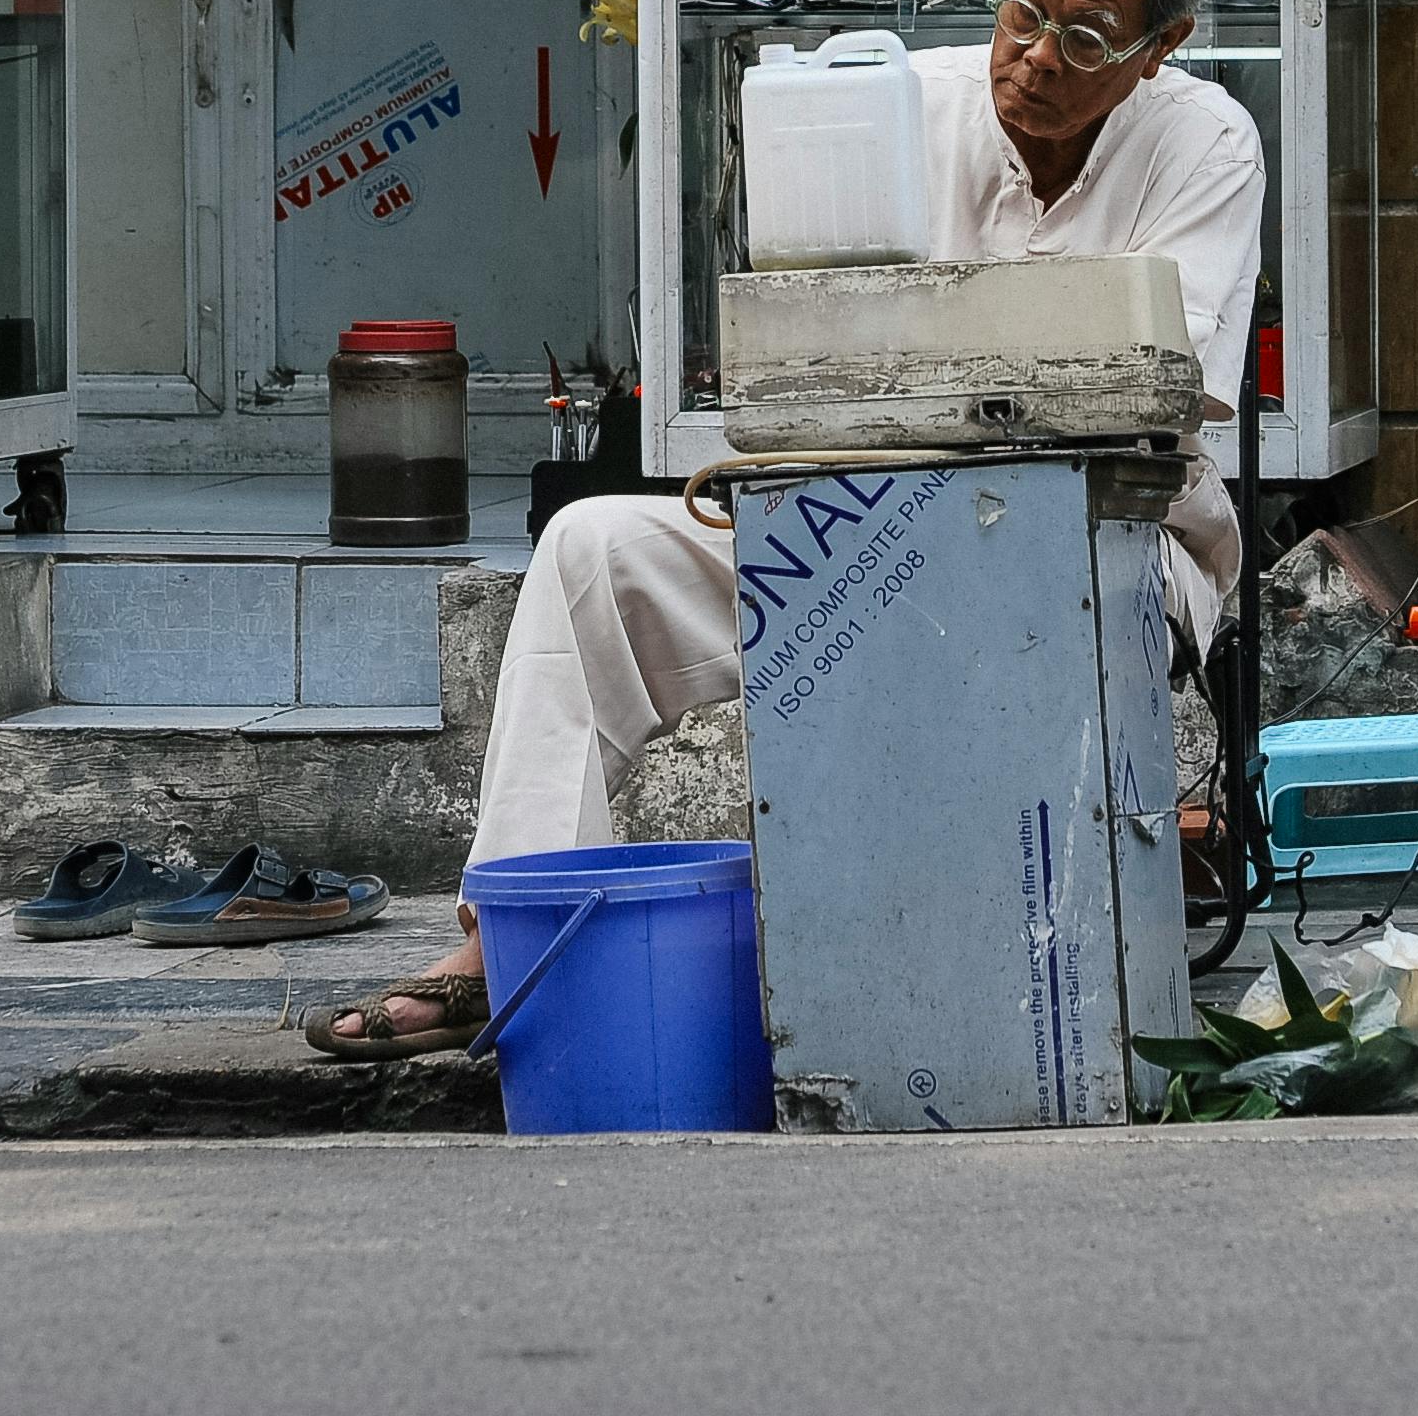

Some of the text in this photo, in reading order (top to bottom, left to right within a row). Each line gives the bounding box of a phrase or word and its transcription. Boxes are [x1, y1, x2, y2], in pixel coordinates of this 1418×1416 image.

[290, 67, 451, 170] ALUMINUM COMPOSITE
[372, 181, 413, 220] HP
[794, 522, 906, 644] COMPOSITE
[773, 675, 816, 722] ISO
[813, 619, 865, 677] 9001
[872, 548, 927, 609] 2008
[1019, 808, 1033, 860] within
[1022, 863, 1037, 895] film
[1030, 987, 1044, 1015] the
[1033, 1019, 1048, 1081] remove
